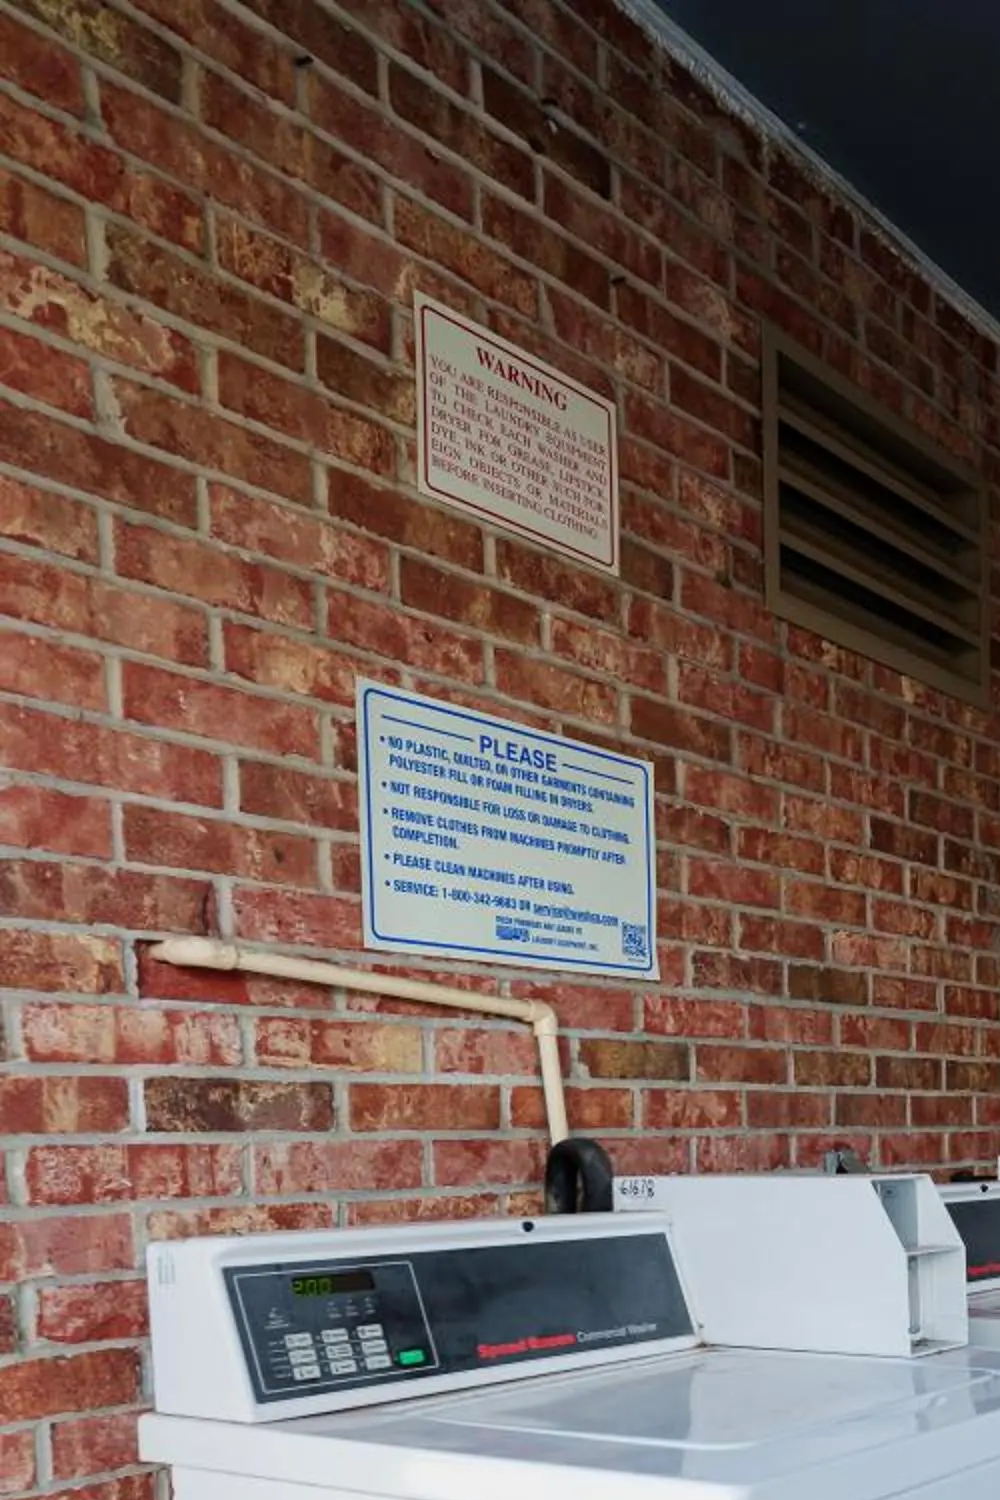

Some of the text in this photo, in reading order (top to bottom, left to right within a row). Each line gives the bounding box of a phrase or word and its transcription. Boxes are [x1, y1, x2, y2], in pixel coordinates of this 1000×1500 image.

[430, 355, 456, 378] YOU
[488, 385, 560, 432] RESPONSIBLE
[477, 347, 567, 410] WARNING
[431, 372, 606, 470] OF THE LAUNDRY EQUIPMENT
[431, 388, 446, 406] TO
[454, 400, 493, 429] CHECK
[501, 423, 531, 447] EACH
[538, 442, 578, 470] WASHER
[432, 406, 471, 434] DRYER
[480, 429, 501, 448] FOR
[466, 438, 484, 456] INK
[512, 460, 547, 485] OTHER
[470, 457, 520, 488] OBJECTS
[549, 494, 608, 528] MATERIALS
[483, 479, 541, 513] INSERTING
[388, 736, 403, 749] NO
[406, 741, 450, 761] PLASTIC,
[496, 763, 508, 775] OR
[511, 767, 538, 783] OTHER
[542, 775, 586, 794] GARMENTS
[588, 787, 634, 806] CONTAINING
[389, 755, 444, 777] POLYESTER
[450, 769, 467, 783] FILL
[470, 774, 484, 787] OR
[487, 778, 512, 793] FOAM
[515, 785, 548, 801] FILLING
[550, 793, 558, 804] IN
[479, 736, 557, 772] PLEASE
[391, 781, 410, 796] NOT
[414, 786, 480, 811] RESPONSIBLE
[484, 802, 500, 815] FOR
[503, 806, 525, 820] LOSS
[528, 812, 540, 824] OR
[543, 815, 577, 831] DAMAGE
[580, 824, 590, 834] TO
[392, 808, 625, 864] REMOVE CLOTHES FROM MACHINES PROMPTLY AFTER
[393, 826, 459, 849] COMPLETION.
[393, 853, 431, 869] PLEASE
[435, 861, 465, 875] CLEAN
[469, 867, 515, 883] MACHINES
[518, 875, 544, 888] AFTER
[394, 880, 437, 896] SERVICE:
